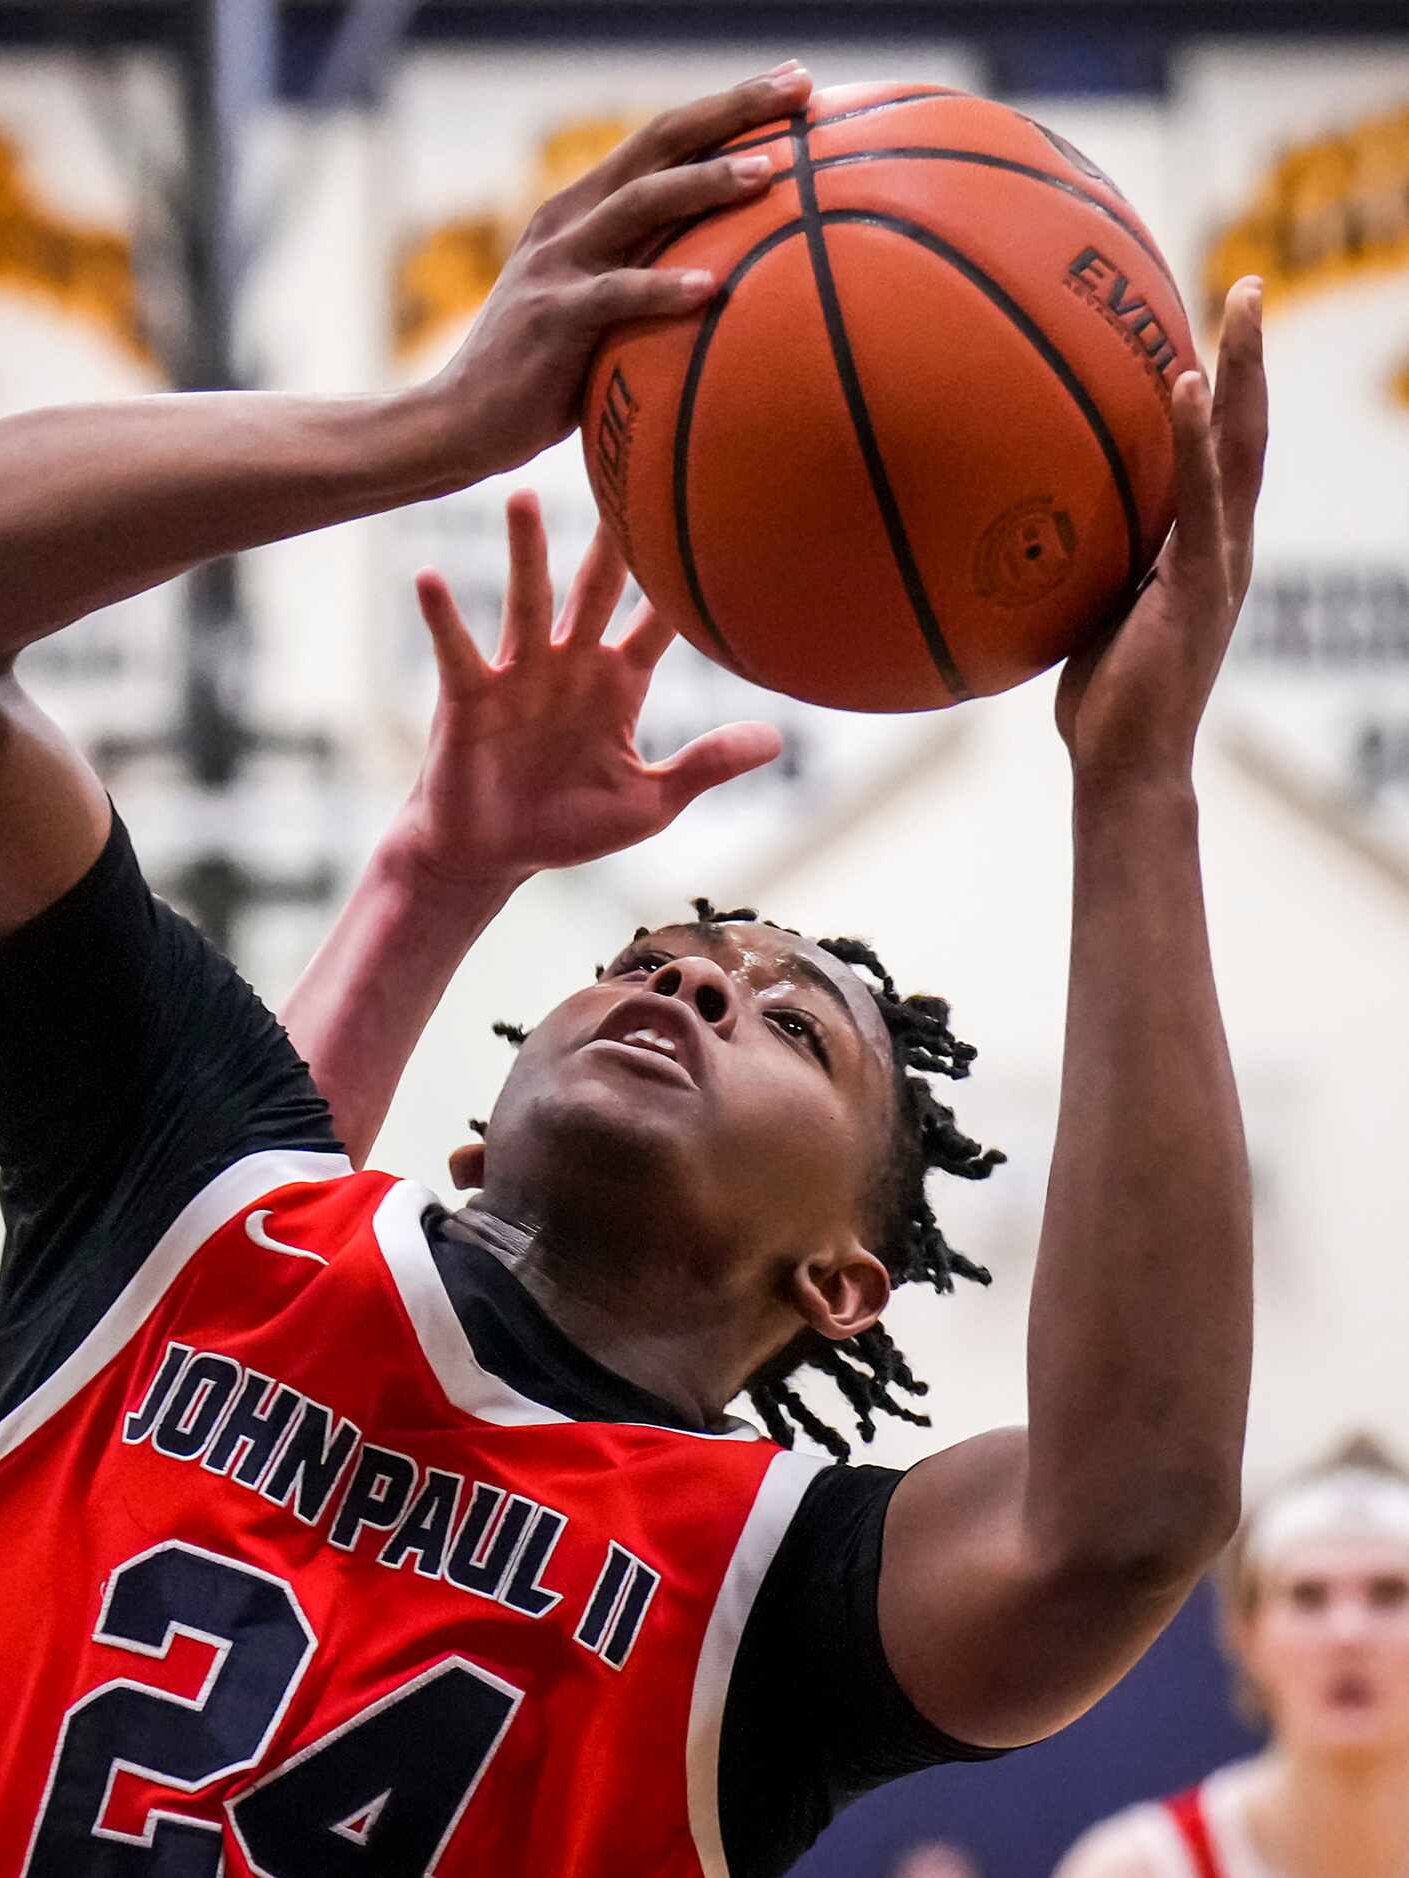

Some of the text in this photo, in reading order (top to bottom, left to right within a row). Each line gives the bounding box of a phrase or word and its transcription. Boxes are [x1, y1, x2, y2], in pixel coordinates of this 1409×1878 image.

[1068, 246, 1179, 388] EVOL
[122, 1340, 662, 1672] JOHN PAUL II
[20, 1539, 526, 1877] 24
